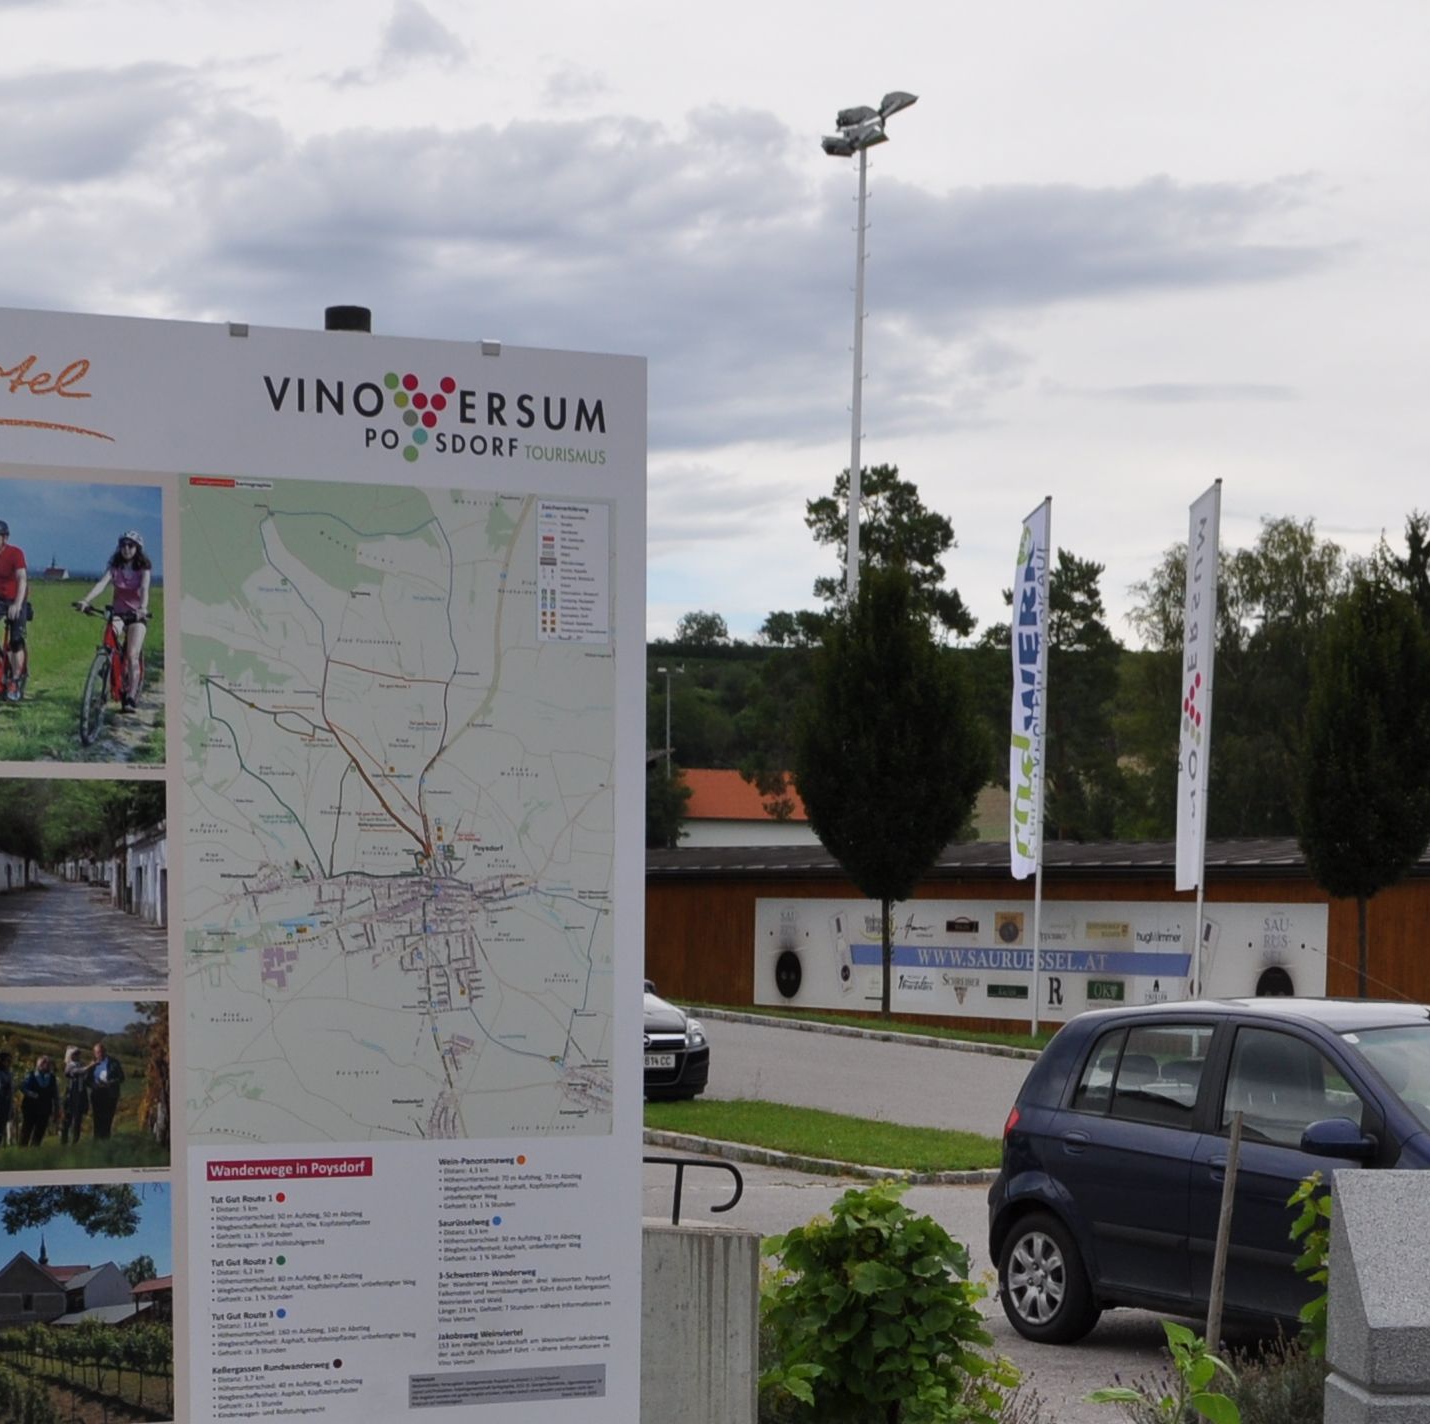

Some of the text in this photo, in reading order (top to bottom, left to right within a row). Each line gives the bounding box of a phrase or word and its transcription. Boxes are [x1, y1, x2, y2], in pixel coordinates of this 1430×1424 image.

[525, 445, 607, 465] TOURISMUS
[472, 844, 503, 854] Poysdorf
[917, 947, 1109, 972] WWW.SAURUESSEL.AT
[438, 1157, 514, 1166] Wein-Panoramaweg
[210, 1161, 365, 1178] Wanderwege in Poysdorf
[211, 1196, 223, 1204] Tut
[226, 1195, 241, 1203] Gut
[242, 1195, 266, 1203] Route
[438, 1218, 490, 1228] Saurüsselweg
[212, 1259, 224, 1267] Tut
[226, 1258, 241, 1266] Gut
[243, 1257, 267, 1266] Route
[212, 1313, 224, 1321] Tut
[227, 1312, 241, 1320] Gut
[243, 1311, 267, 1319] Route
[438, 1329, 523, 1340] Jakobsweg Weinviertel
[212, 1362, 330, 1376] Kellergassen Rundwanderweg
